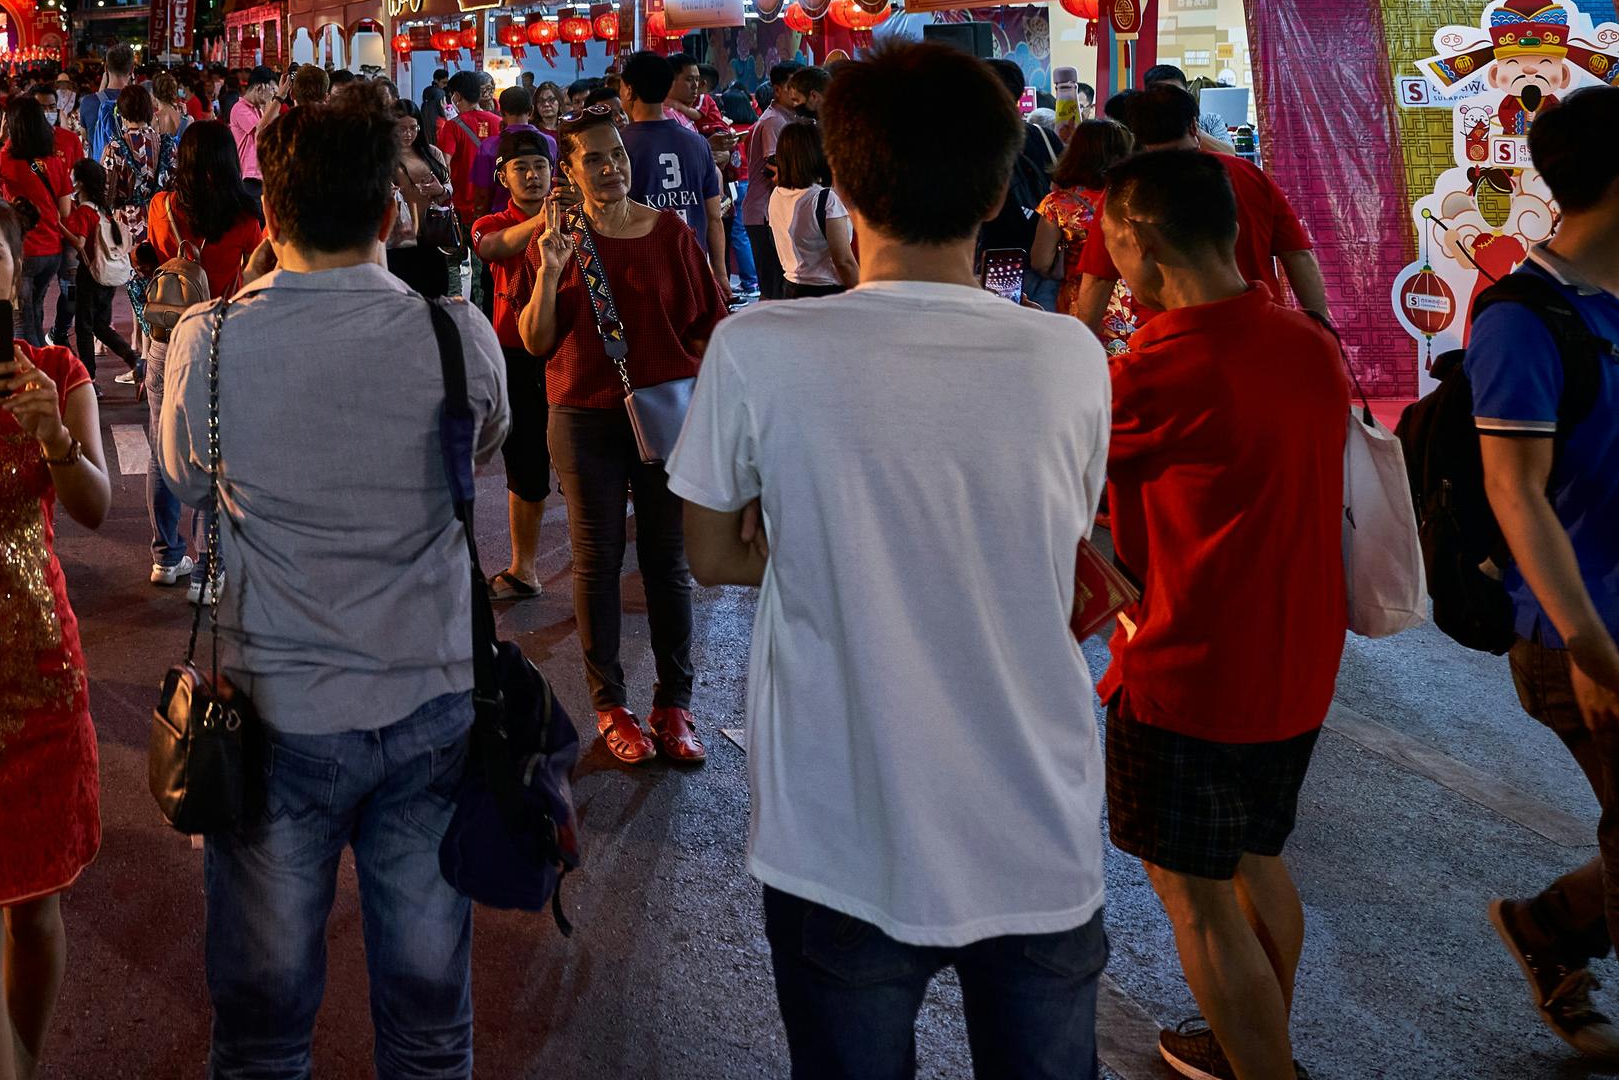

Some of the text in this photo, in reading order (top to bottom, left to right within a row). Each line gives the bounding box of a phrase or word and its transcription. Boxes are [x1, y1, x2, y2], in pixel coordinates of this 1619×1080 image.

[1408, 83, 1424, 102] S
[1499, 143, 1512, 162] S
[658, 152, 683, 190] 3
[644, 190, 699, 209] KOREA
